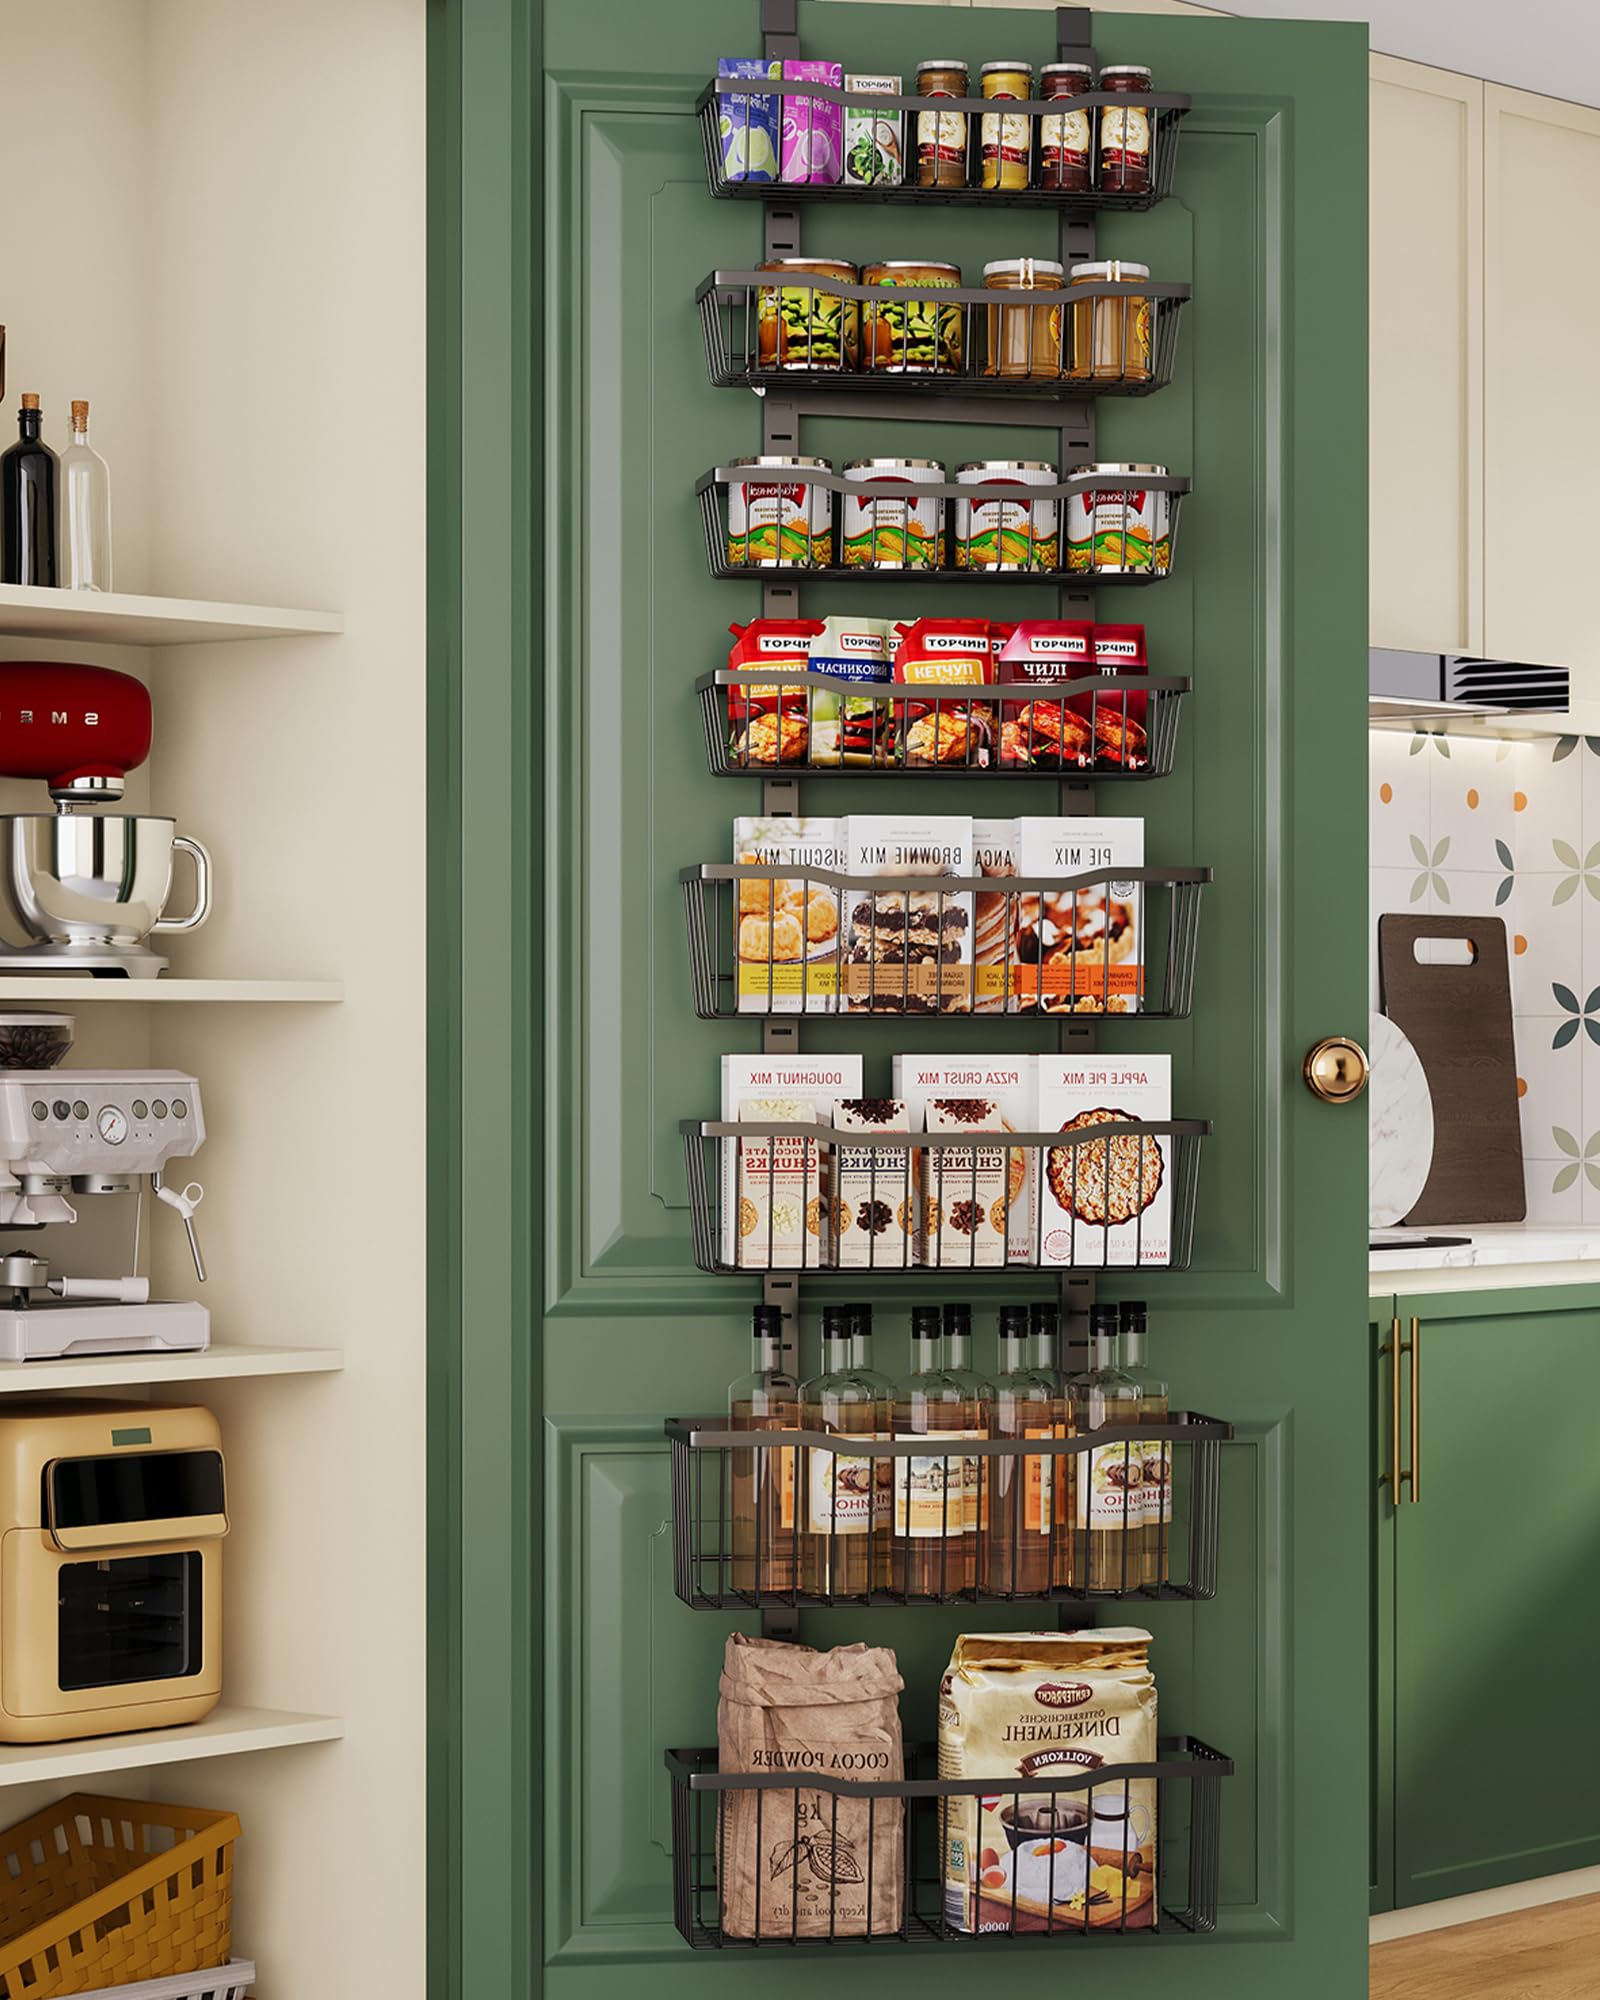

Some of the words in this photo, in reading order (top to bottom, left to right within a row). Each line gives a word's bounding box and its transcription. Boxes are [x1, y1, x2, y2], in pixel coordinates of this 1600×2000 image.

[856, 79, 892, 90] ТОРЧИН
[763, 639, 810, 649] ТОРЧИ
[844, 637, 881, 648] ТОРЧИН
[928, 638, 987, 649] ТОРЧИН
[1033, 639, 1084, 650] ТОРЧИН
[1095, 643, 1135, 653] ОРЧИН
[914, 663, 973, 679] КЕТЧУП
[1023, 663, 1067, 676] ЧИЛІ
